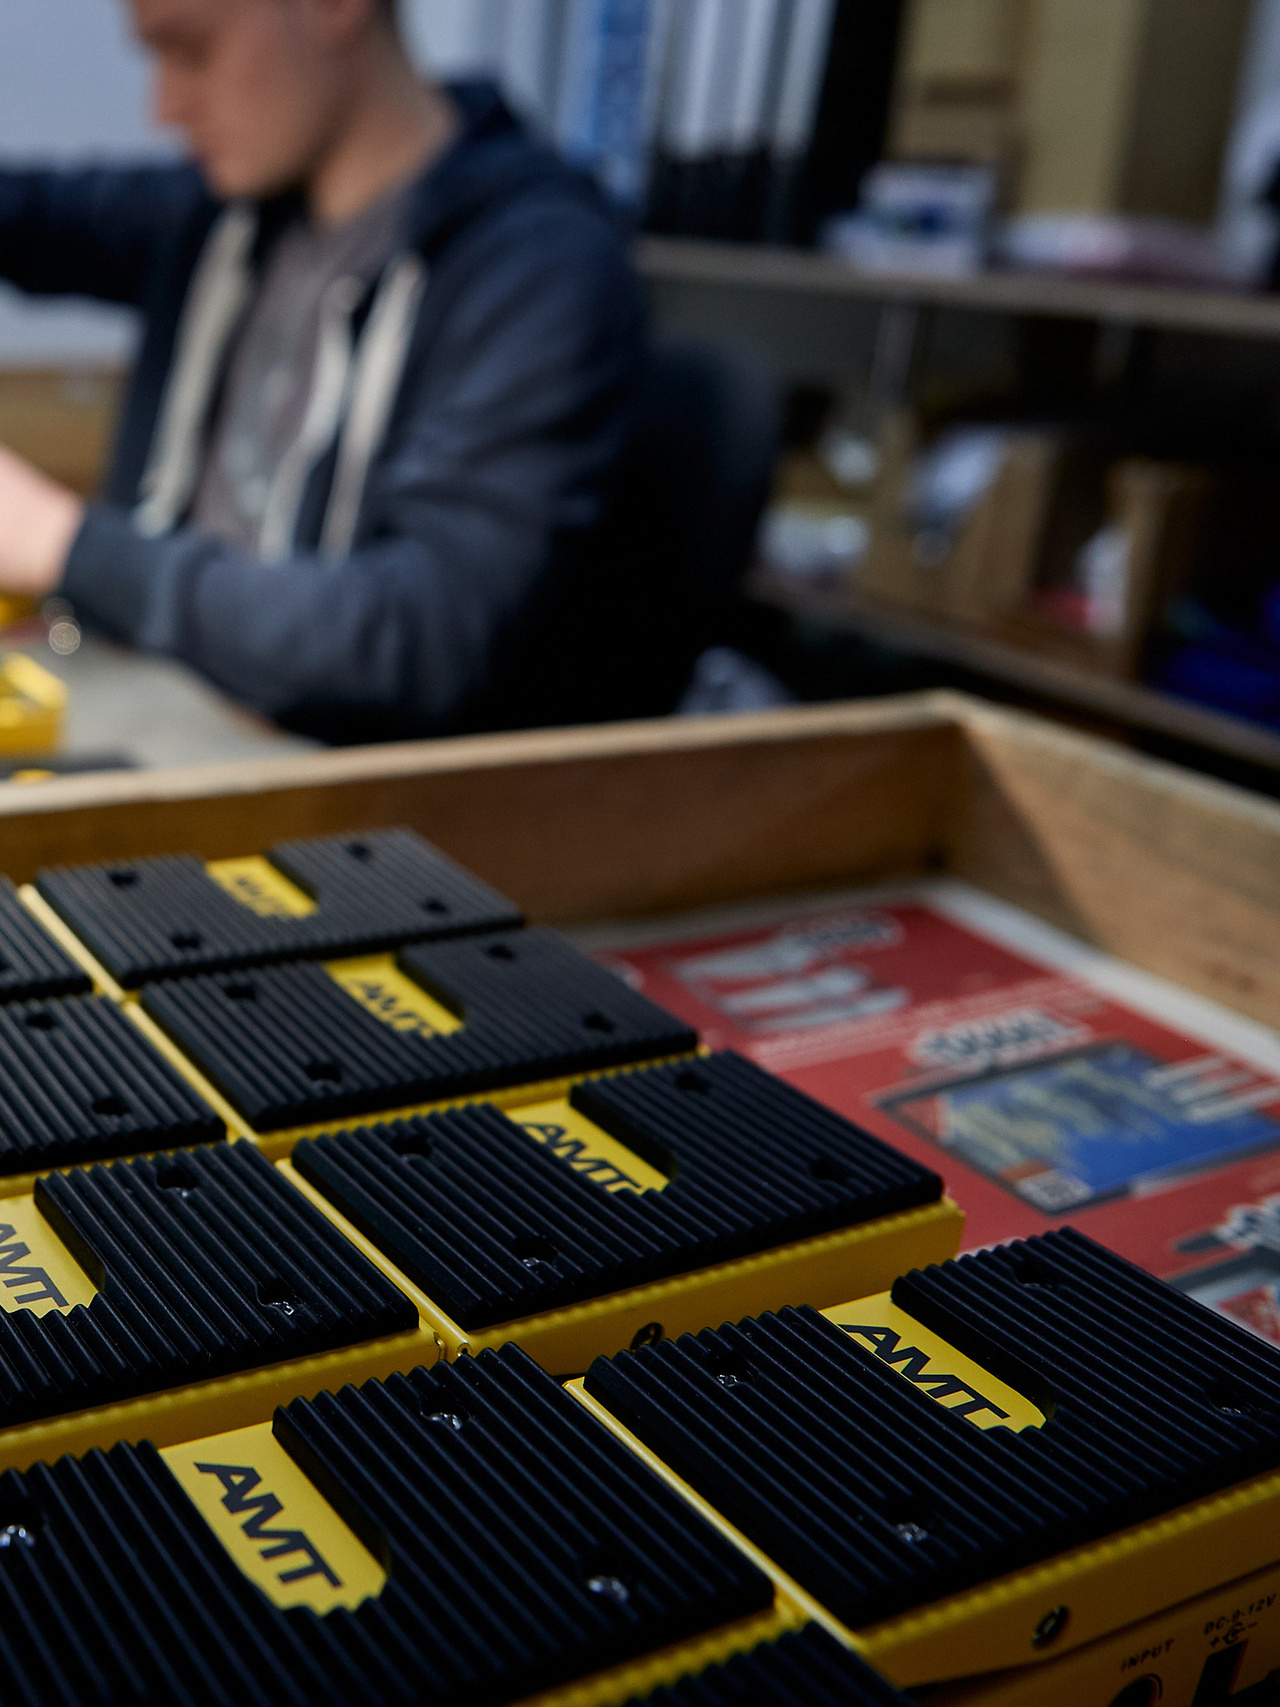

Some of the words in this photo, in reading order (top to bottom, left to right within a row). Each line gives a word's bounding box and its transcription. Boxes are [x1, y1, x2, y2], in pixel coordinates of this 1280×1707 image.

[520, 1122, 643, 1189] AMT
[836, 1323, 1012, 1420] AMT
[192, 1462, 344, 1589] AMT
[1121, 1638, 1175, 1672] INPUT
